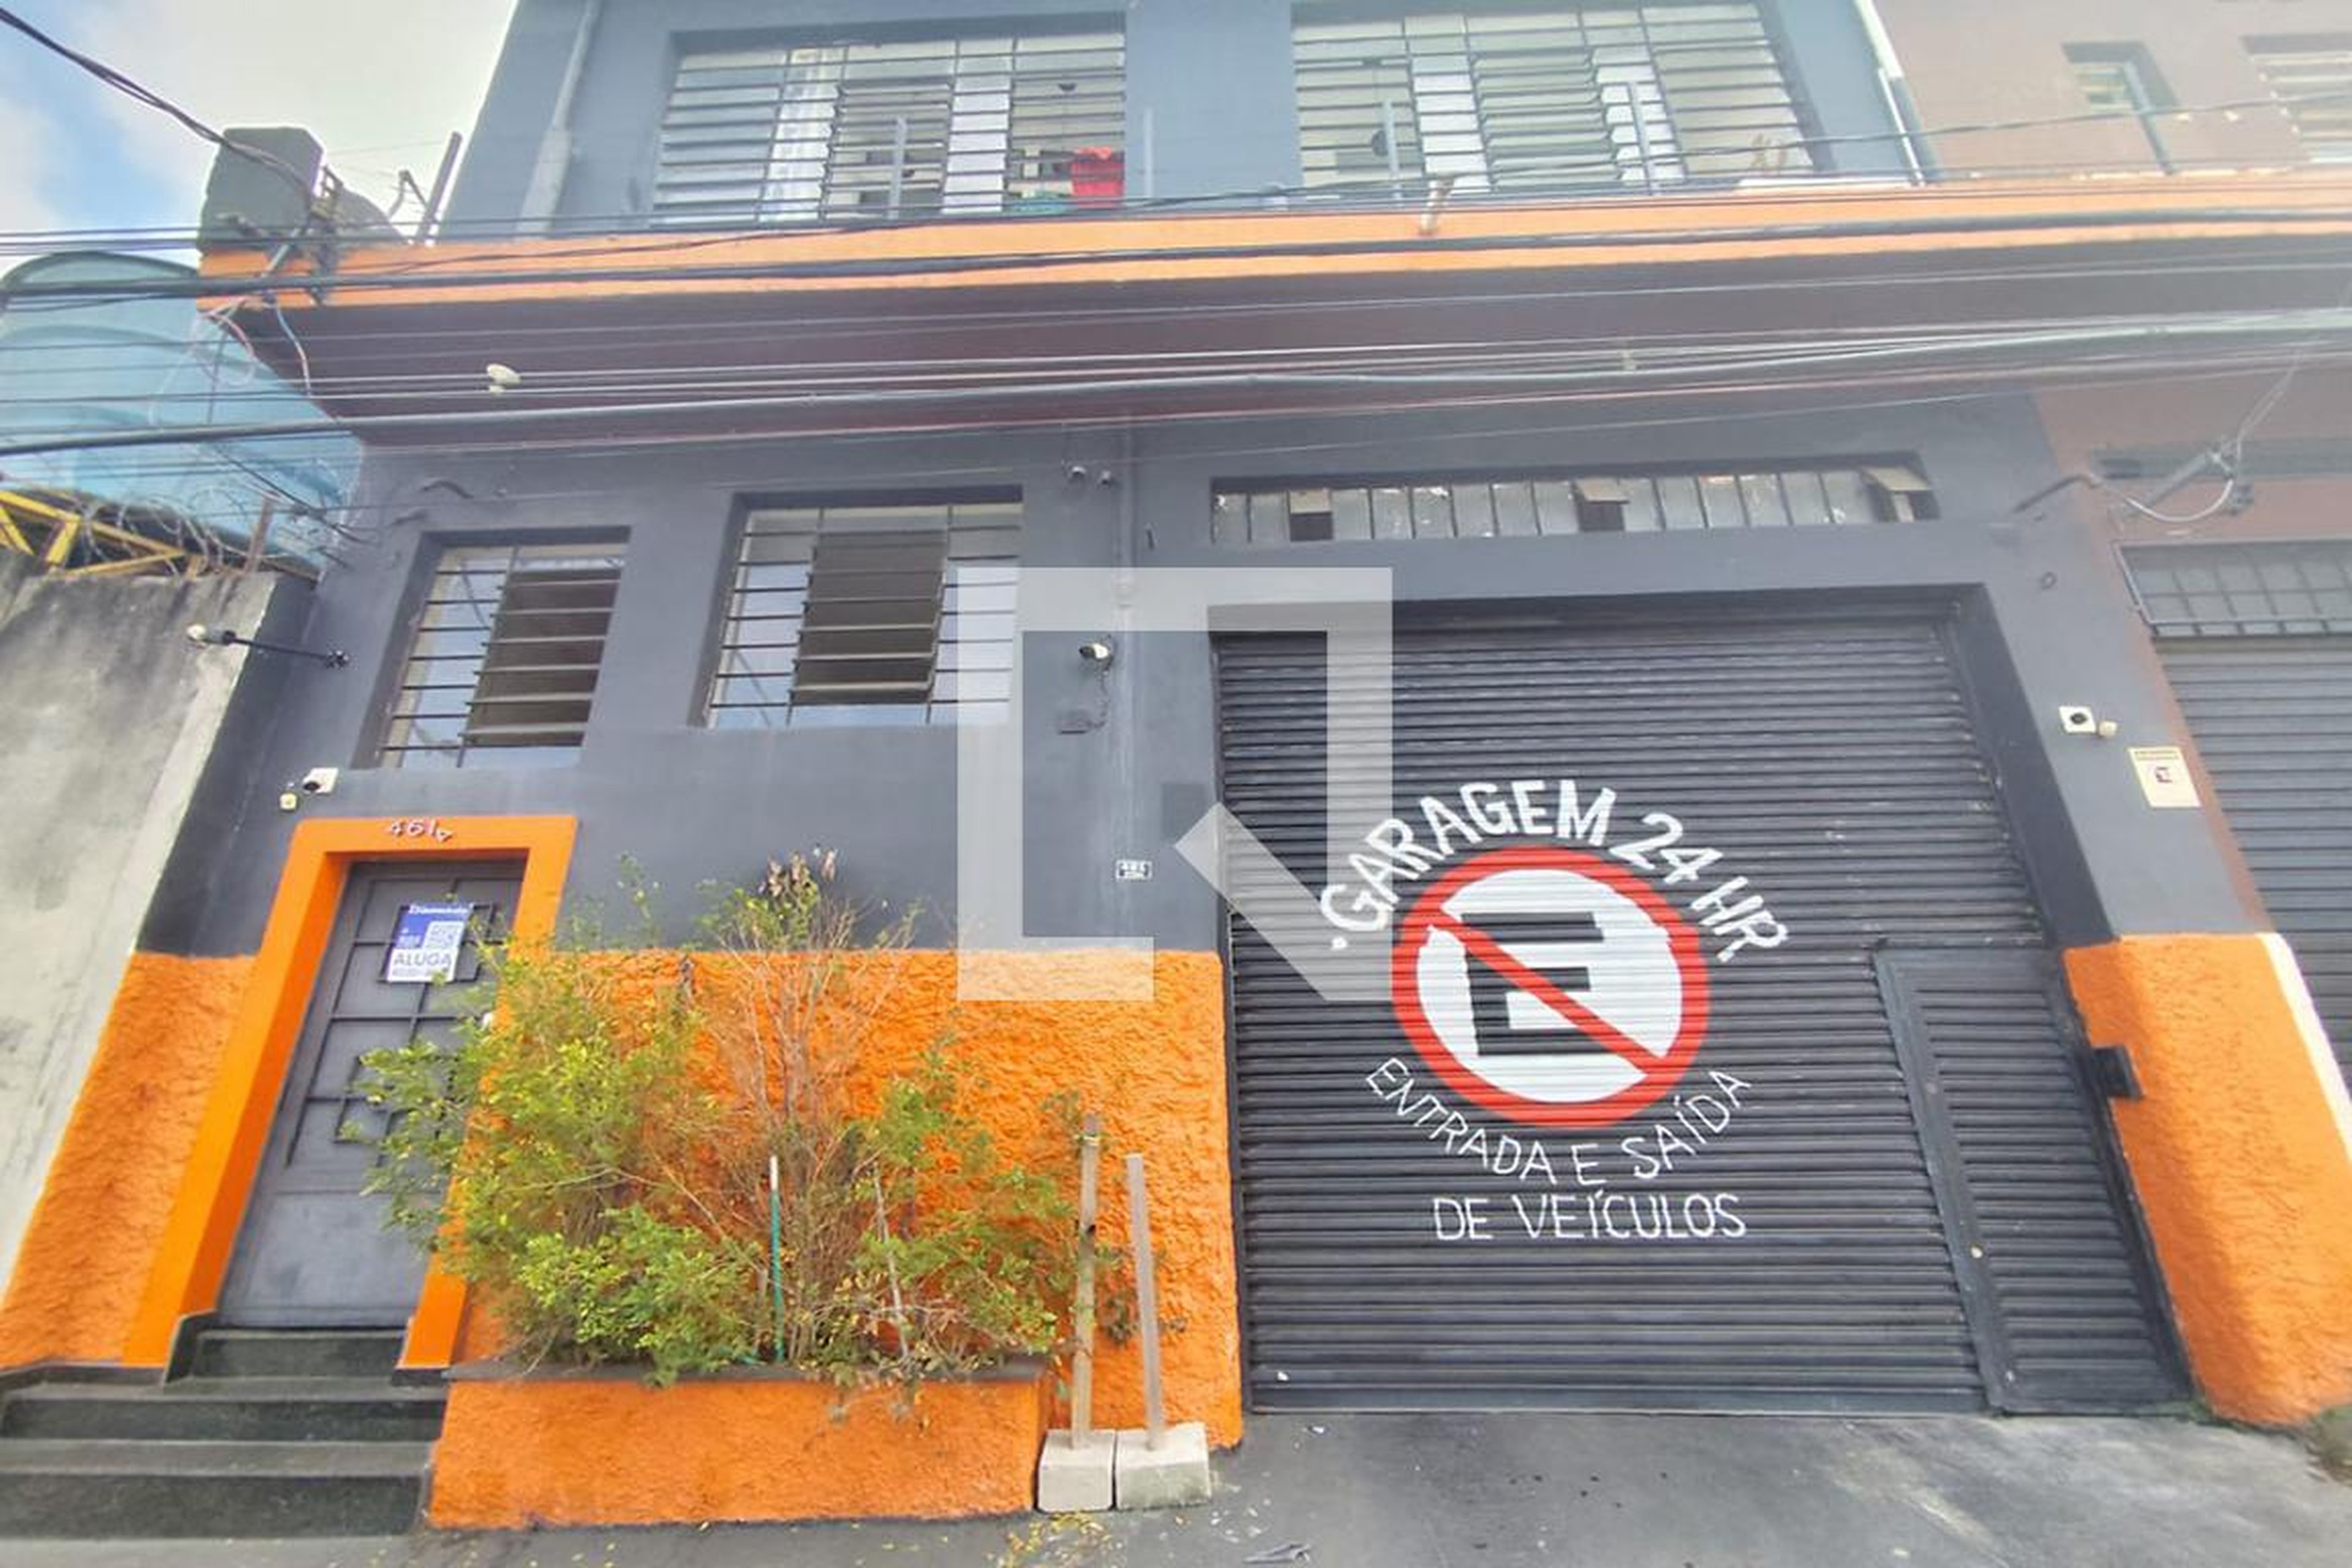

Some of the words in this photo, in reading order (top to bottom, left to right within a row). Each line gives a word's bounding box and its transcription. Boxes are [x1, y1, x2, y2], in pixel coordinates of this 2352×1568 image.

[1608, 812, 1724, 884] 24
[392, 951, 453, 967] ALUGA
[1365, 1057, 1558, 1185] ENTRADA
[1571, 1144, 1607, 1185] E
[1621, 1069, 1752, 1179] SAÍDA
[1433, 1197, 1493, 1240] DE
[1512, 1189, 1747, 1239] VEÍCULOS
